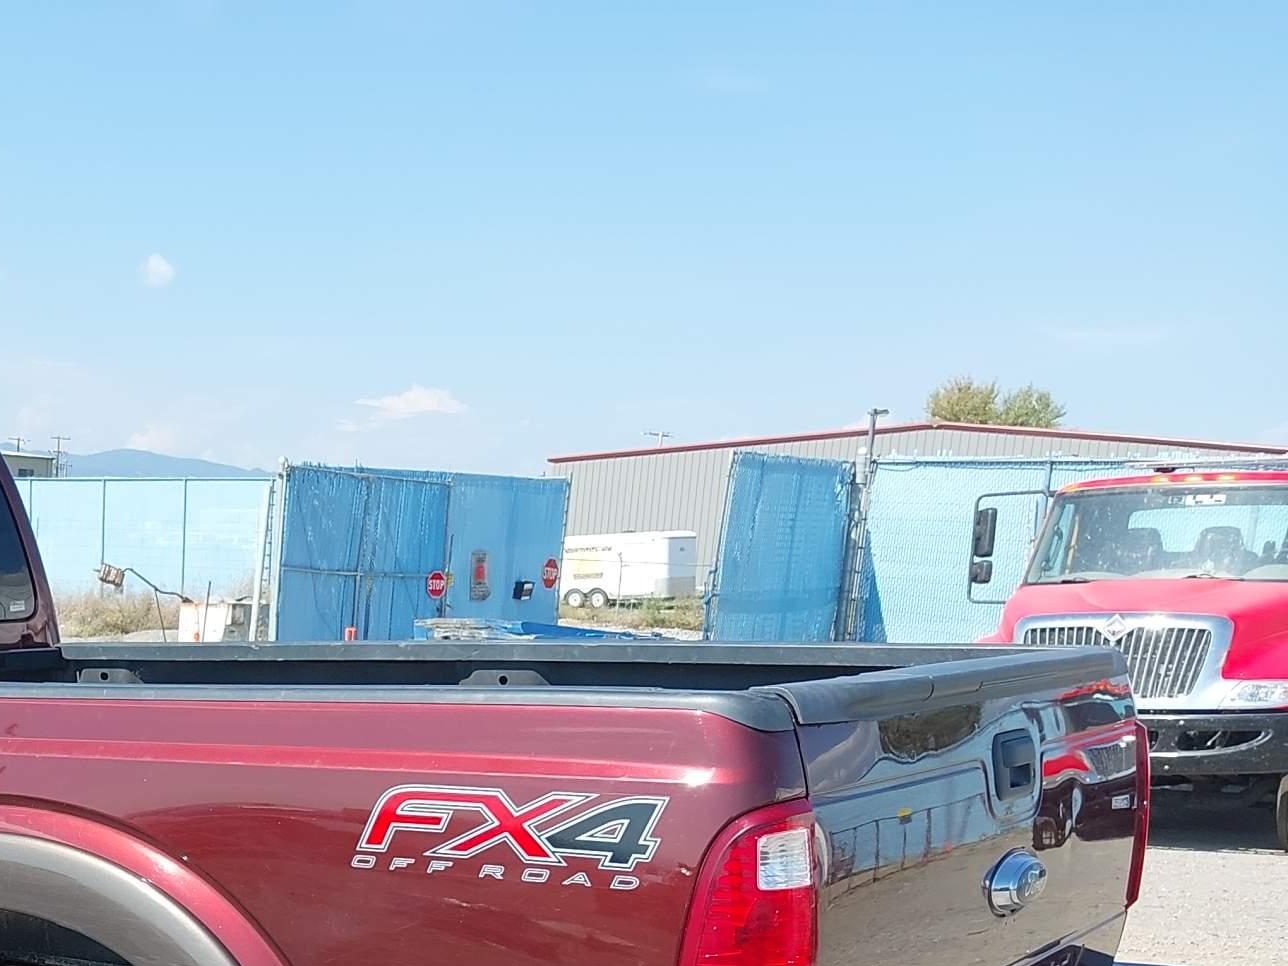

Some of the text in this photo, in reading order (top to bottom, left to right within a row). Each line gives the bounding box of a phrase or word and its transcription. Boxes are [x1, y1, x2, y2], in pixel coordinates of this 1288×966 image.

[428, 580, 445, 590] STOP
[543, 567, 558, 579] STOP
[355, 783, 670, 871] FX4
[350, 854, 640, 890] OFF ROAD
